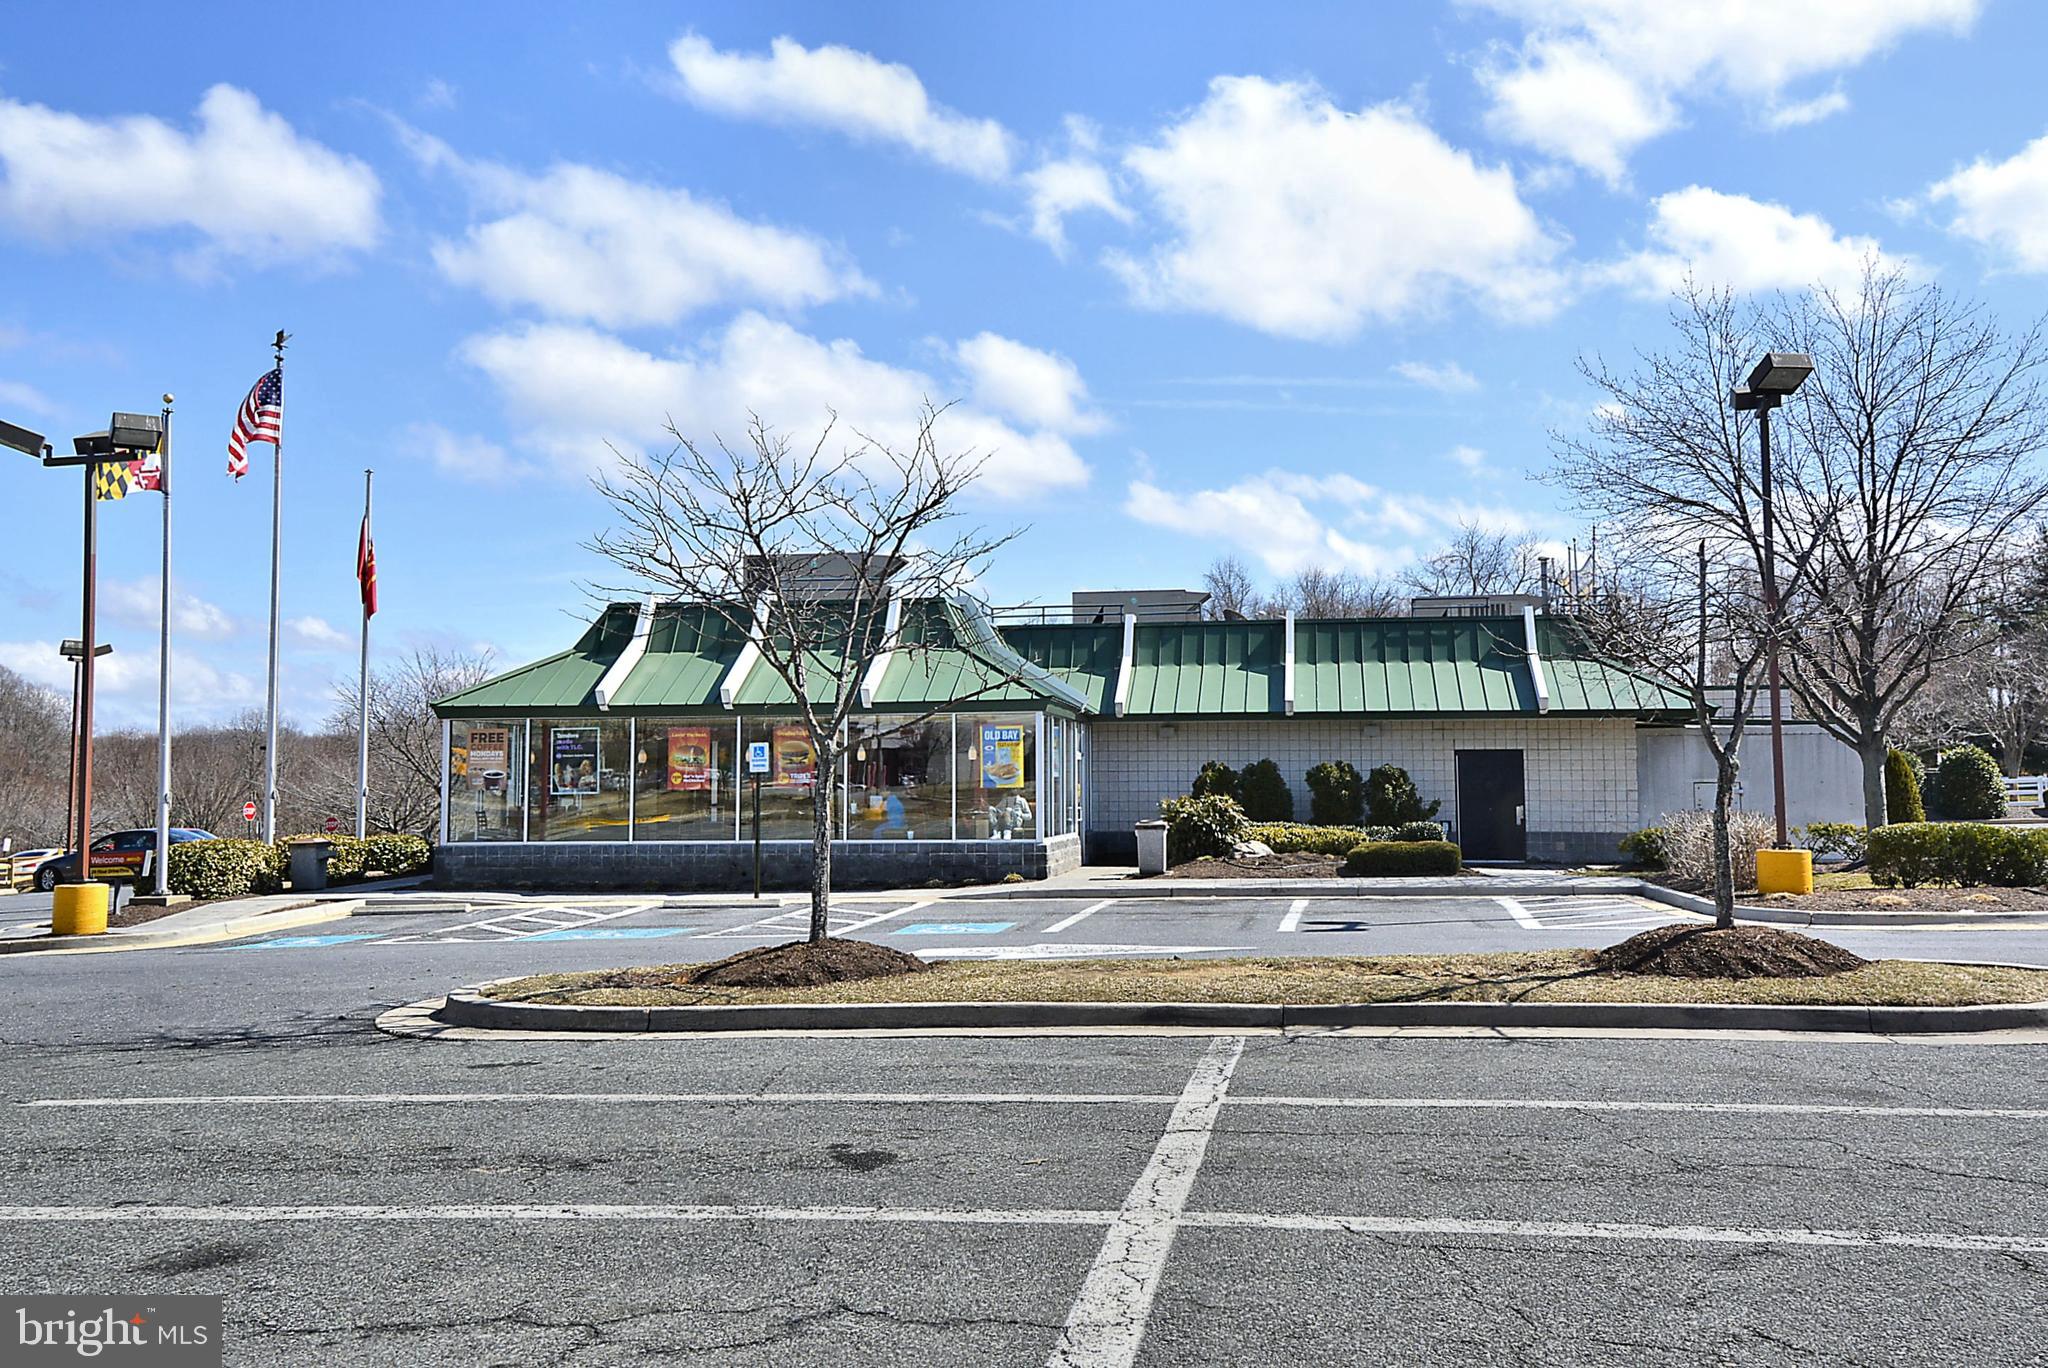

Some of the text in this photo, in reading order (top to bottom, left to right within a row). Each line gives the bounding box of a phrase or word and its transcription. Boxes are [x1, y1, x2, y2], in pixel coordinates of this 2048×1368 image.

[470, 732, 504, 743] FREE
[984, 730, 1018, 740] OLD BAY
[471, 743, 504, 751] COFFEE
[91, 856, 125, 864] Welcome
